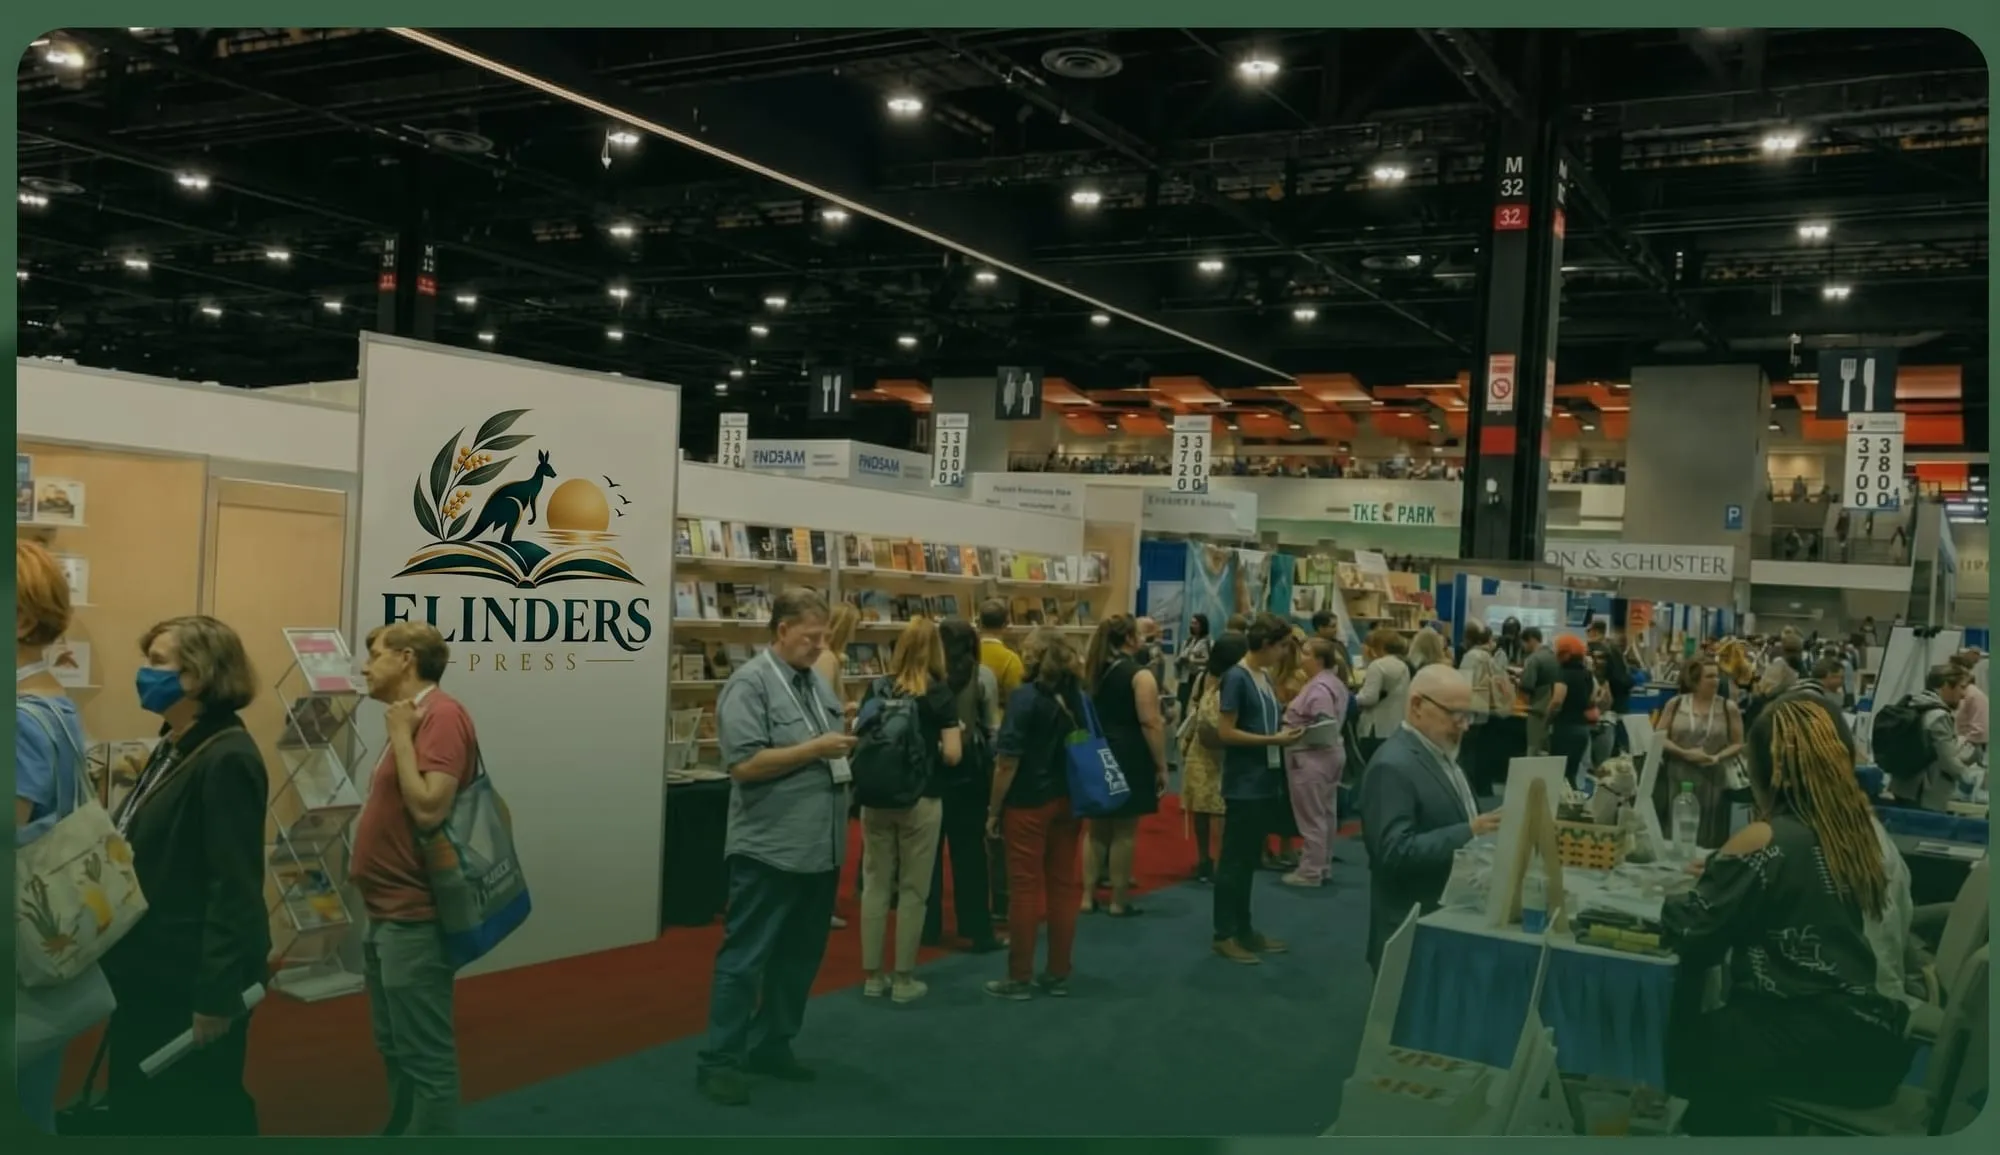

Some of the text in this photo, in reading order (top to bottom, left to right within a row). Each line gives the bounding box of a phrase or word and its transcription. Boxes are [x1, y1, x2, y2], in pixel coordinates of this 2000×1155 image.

[1505, 156, 1523, 174] M
[1500, 178, 1524, 197] 32
[1500, 208, 1521, 226] 32
[939, 431, 948, 484] 3700
[1177, 435, 1189, 490] 3720
[1855, 437, 1870, 507] 3700
[1876, 437, 1892, 508] 3800
[1397, 504, 1436, 523] PARK
[1728, 506, 1741, 524] P
[1583, 548, 1602, 569] &
[1610, 552, 1728, 575] SCHUSTER
[382, 593, 652, 651] FLINDERS
[469, 653, 577, 671] PRESS
